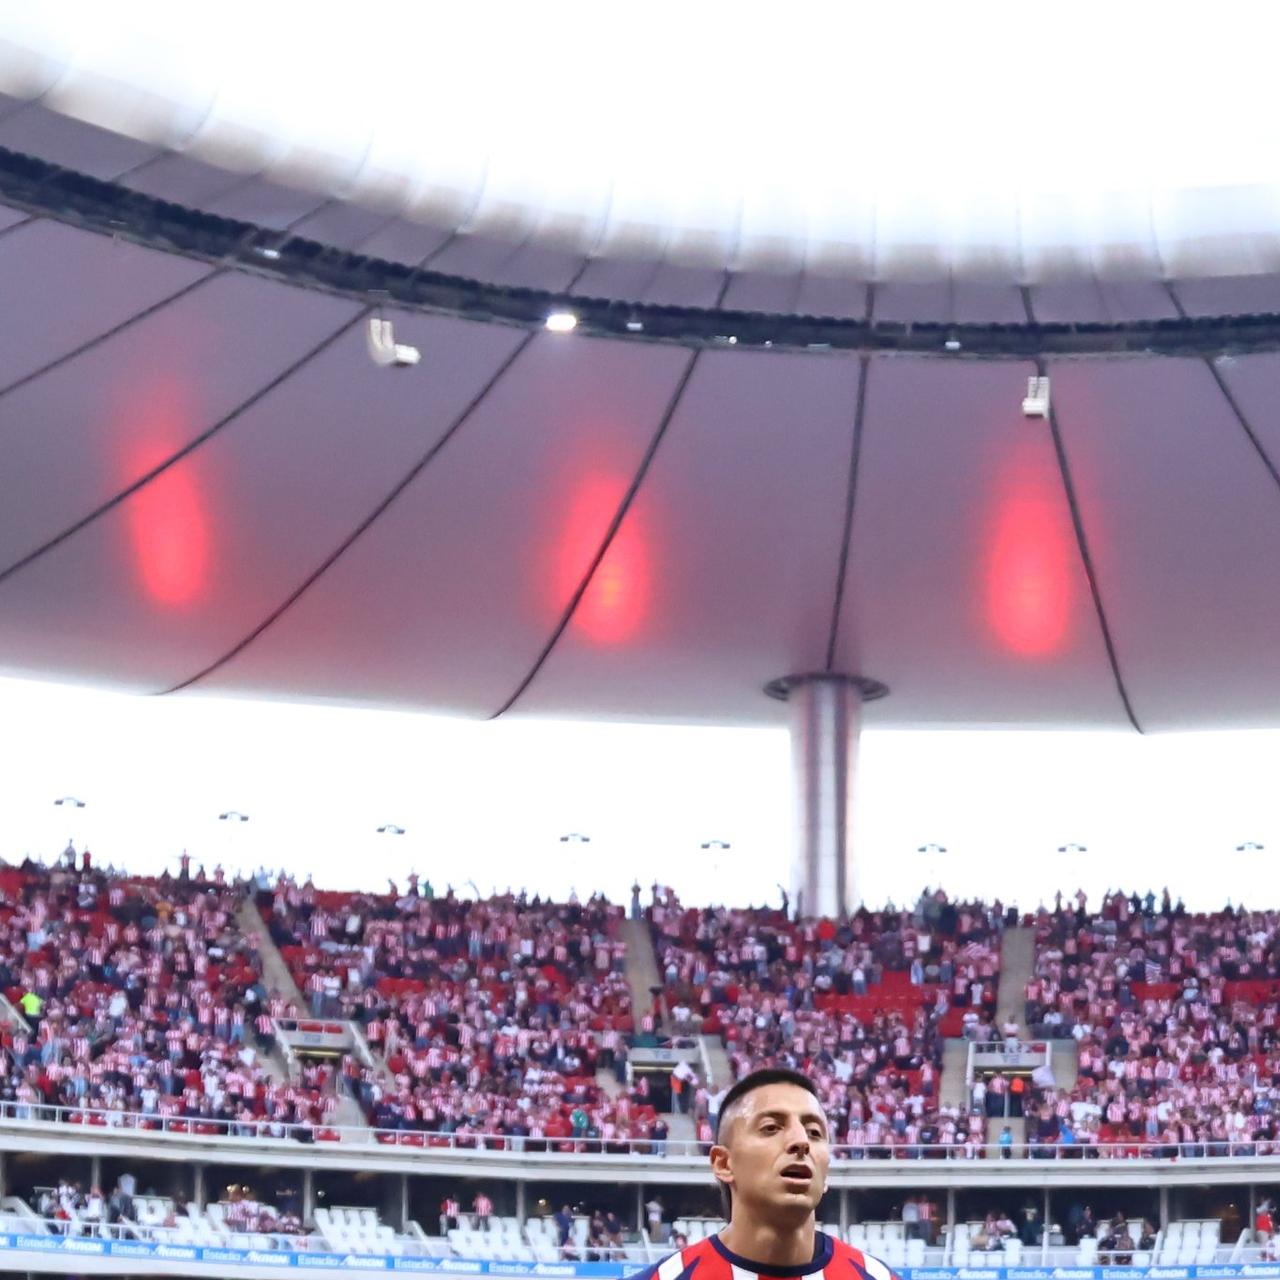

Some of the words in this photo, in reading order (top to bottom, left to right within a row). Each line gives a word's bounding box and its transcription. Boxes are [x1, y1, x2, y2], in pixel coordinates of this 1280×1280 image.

[17, 1237, 56, 1248] Estadio
[111, 1243, 150, 1255] Estadio
[203, 1250, 240, 1261] Estadio
[299, 1255, 338, 1266] Estadio
[394, 1258, 433, 1270] Estadio
[489, 1262, 528, 1274] Estadio
[911, 1269, 950, 1279] Estadio
[1007, 1269, 1046, 1279] Estadio
[1103, 1268, 1141, 1279] Estadio
[1196, 1266, 1235, 1277] Estadio
